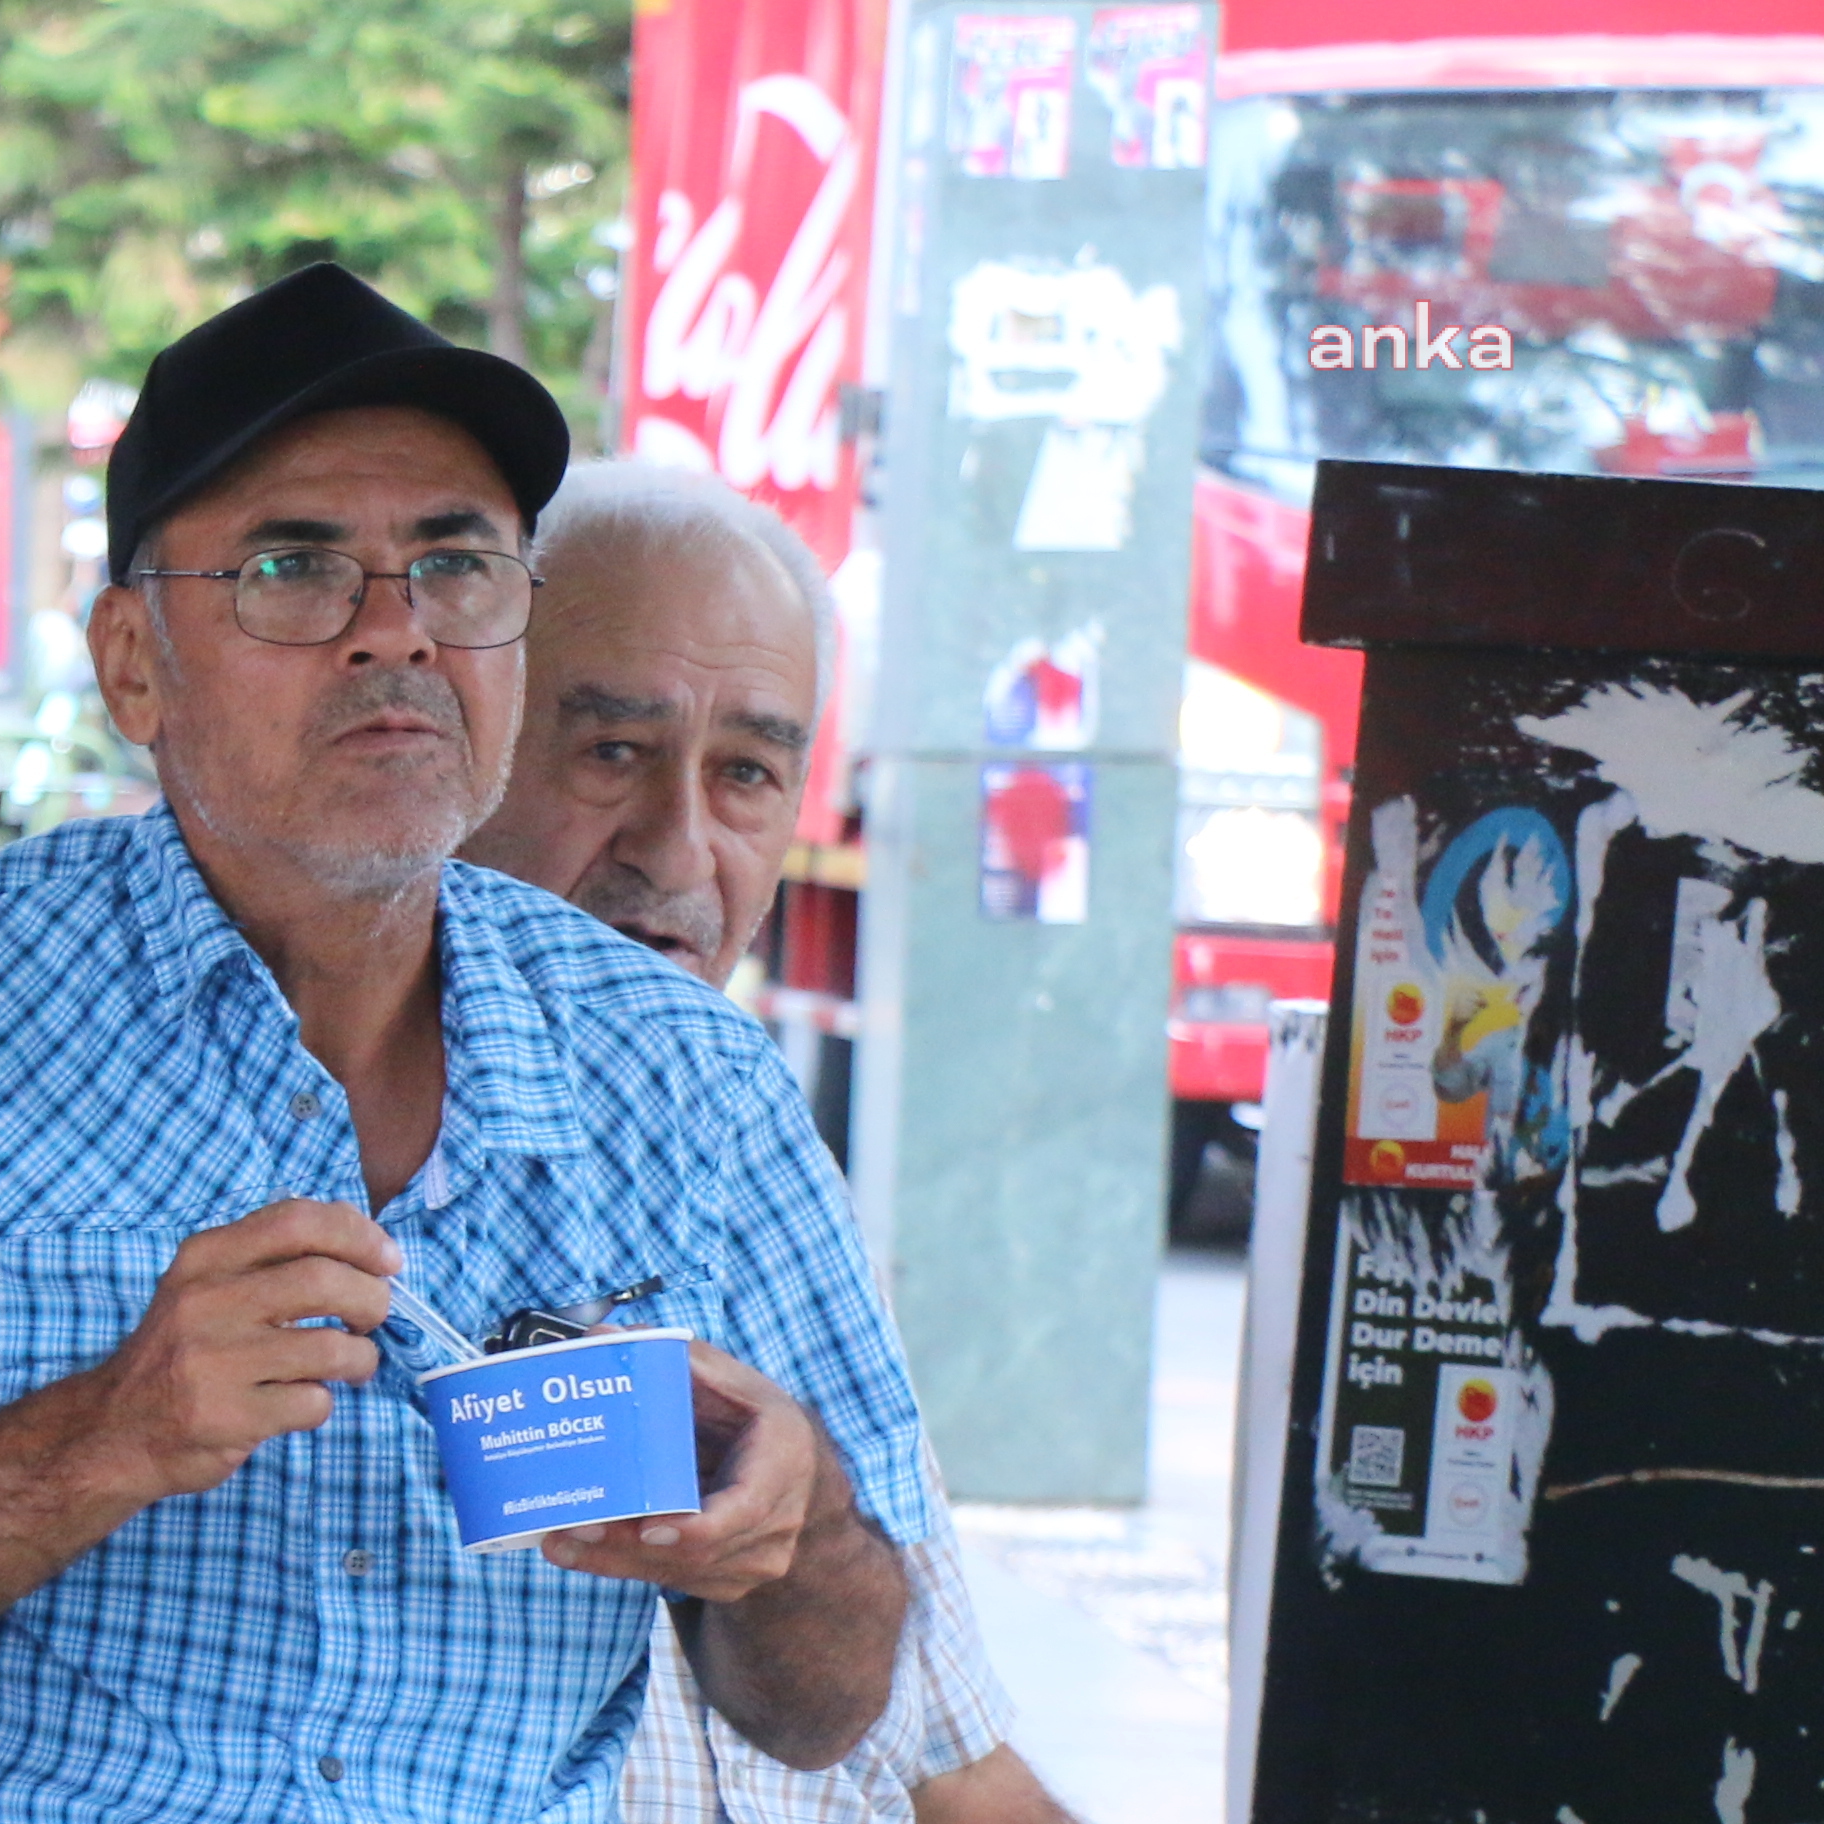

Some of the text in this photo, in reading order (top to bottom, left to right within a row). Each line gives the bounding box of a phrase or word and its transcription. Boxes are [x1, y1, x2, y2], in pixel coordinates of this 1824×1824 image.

[1354, 1286, 1406, 1318] Din
[1352, 1321, 1408, 1350] Dur
[1348, 1352, 1403, 1391] için
[450, 1374, 633, 1424] Afiyet Olsun
[480, 1415, 605, 1450] Muhittin BÖCEK
[1455, 1425, 1495, 1441] HKP
